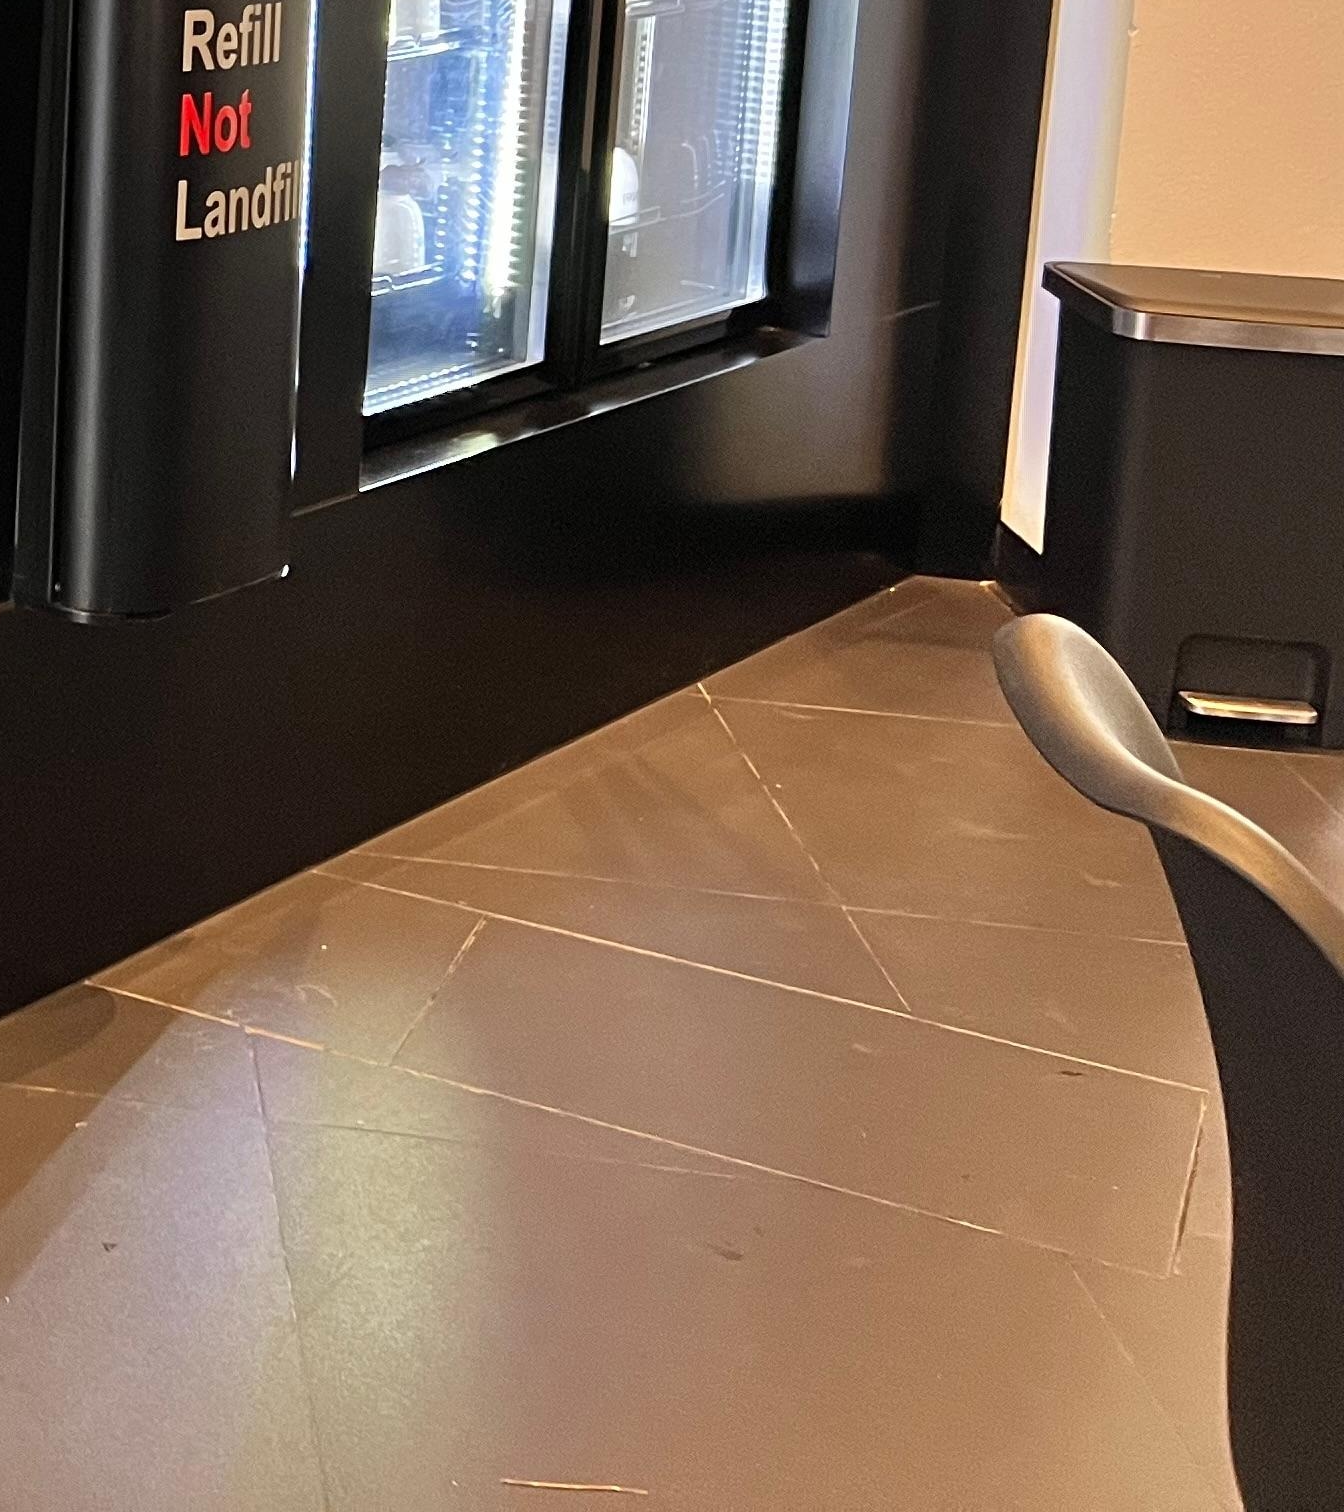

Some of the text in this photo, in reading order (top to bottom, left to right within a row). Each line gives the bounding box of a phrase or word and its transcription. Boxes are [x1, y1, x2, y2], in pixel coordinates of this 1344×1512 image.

[182, 2, 282, 72] Refill
[180, 88, 252, 157] Not
[176, 159, 302, 242] Landfil
